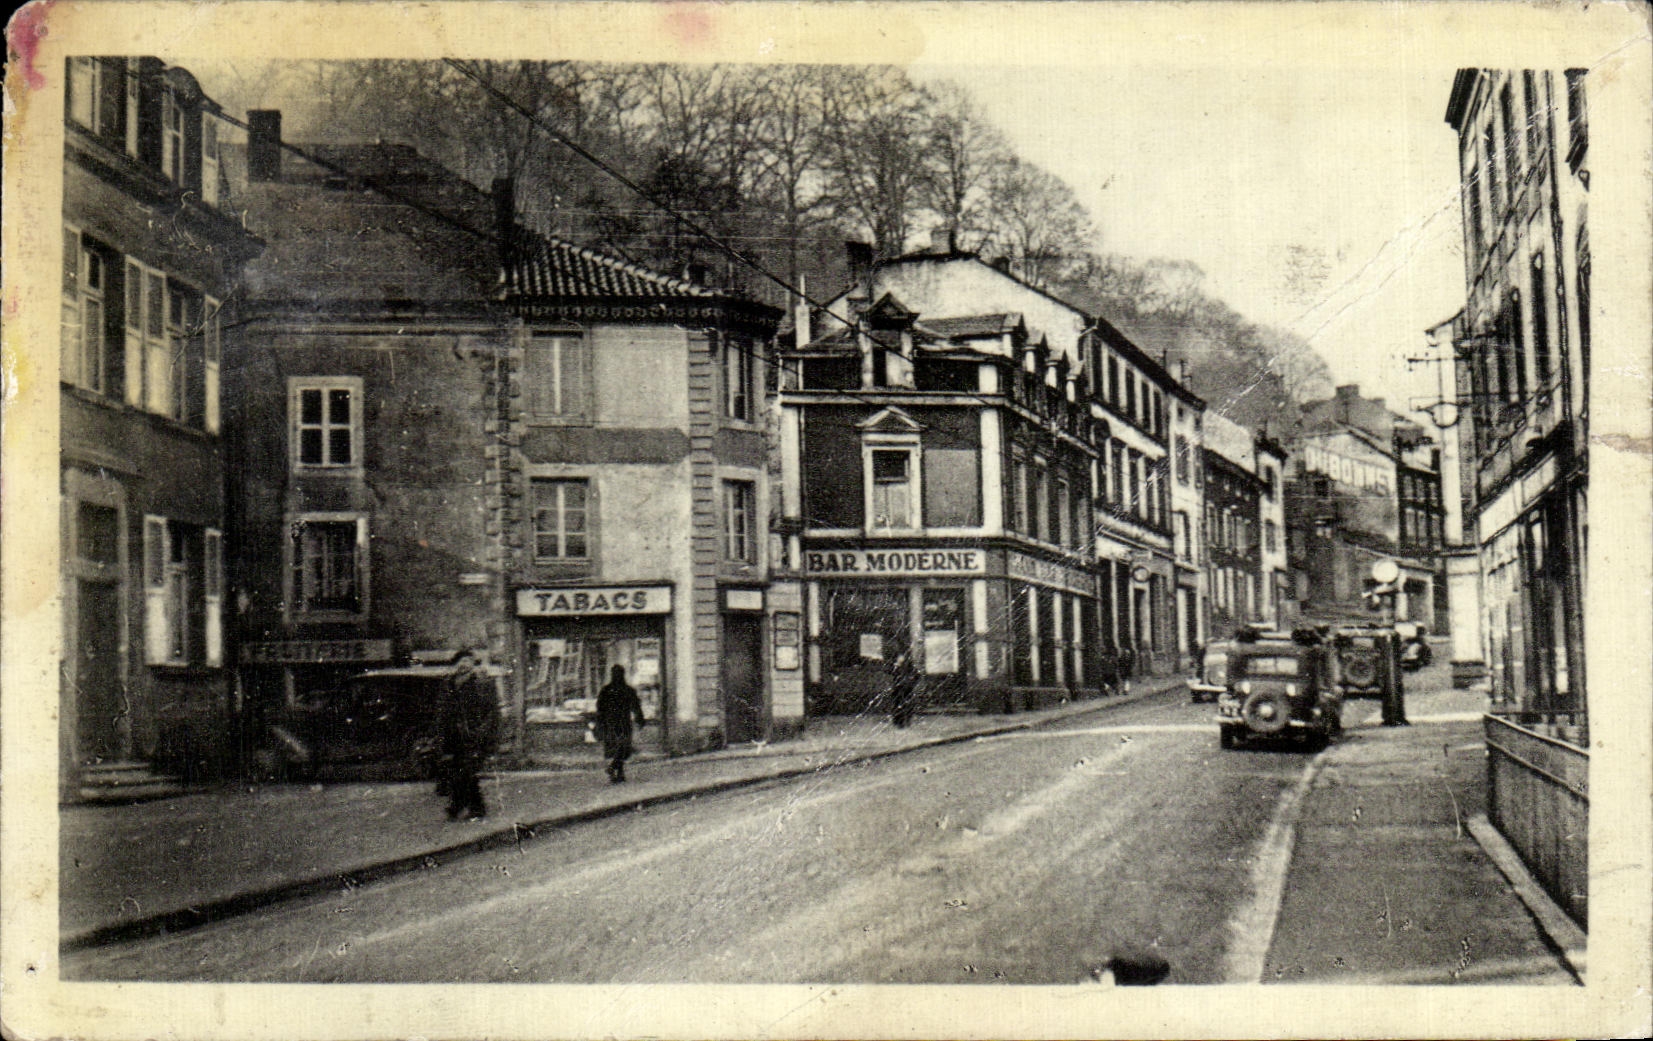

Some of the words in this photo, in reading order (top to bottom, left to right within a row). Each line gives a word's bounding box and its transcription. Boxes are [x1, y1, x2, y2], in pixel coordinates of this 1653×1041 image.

[807, 552, 859, 572] BAR
[866, 551, 979, 571] MODERNE
[533, 590, 647, 612] TABACS
